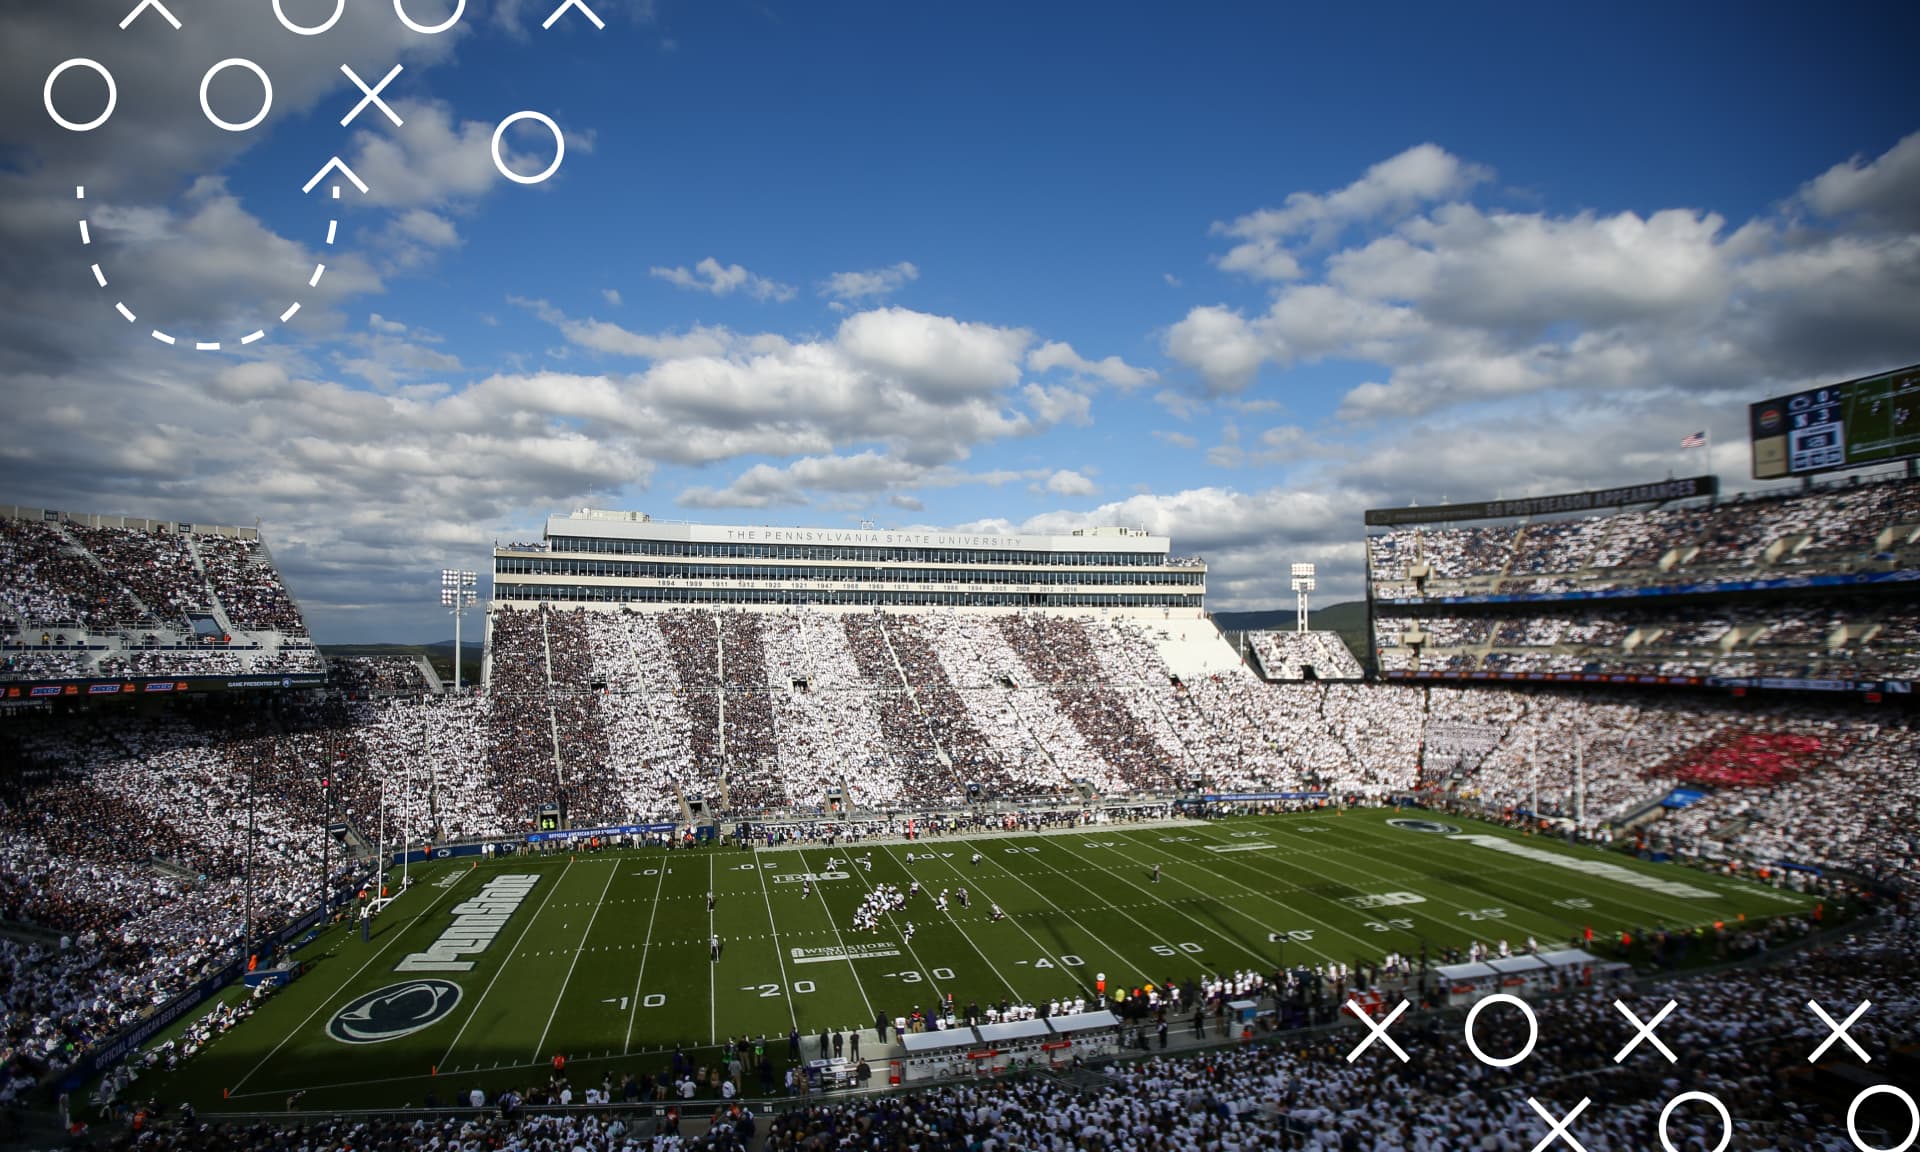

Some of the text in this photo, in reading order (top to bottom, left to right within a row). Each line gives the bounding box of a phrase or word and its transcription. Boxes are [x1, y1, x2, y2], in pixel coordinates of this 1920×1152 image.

[1506, 494, 1591, 515] POSTSEASON
[1595, 479, 1697, 506] APPEARANCES
[728, 530, 1022, 546] THE PENNSYLVANIA STATE UNIVERSITY
[804, 942, 896, 955] WEST SHORE
[95, 1040, 127, 1069] OFFICIAL
[127, 1018, 160, 1045] AMERICAN
